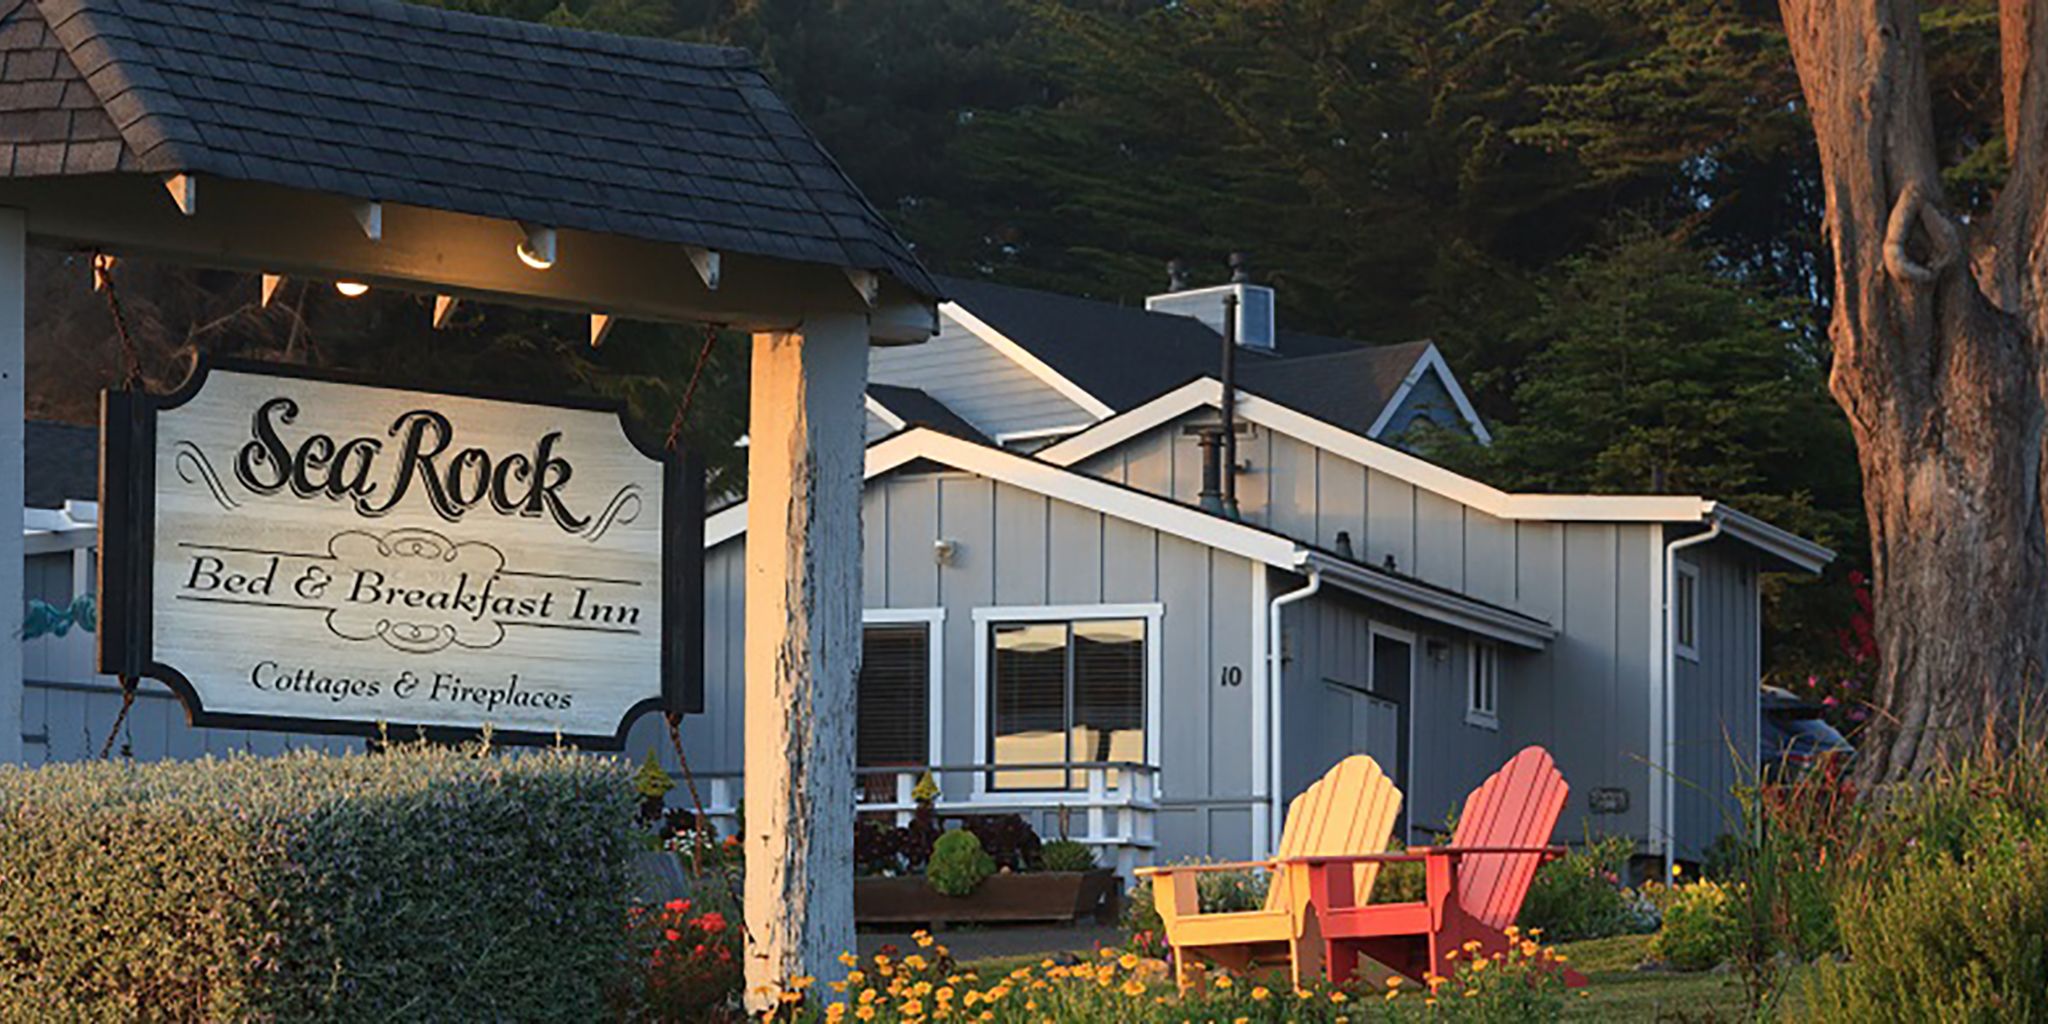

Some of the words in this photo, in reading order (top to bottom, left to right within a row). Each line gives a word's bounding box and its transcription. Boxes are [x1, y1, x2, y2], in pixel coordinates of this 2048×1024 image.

[234, 397, 382, 500] Sea
[355, 409, 591, 537] Rock
[182, 554, 280, 597] Bed
[294, 565, 332, 599] &
[346, 568, 553, 621] Breakfast
[566, 587, 640, 624] Inn
[251, 660, 380, 701] Cottages
[393, 671, 420, 696] &
[429, 673, 572, 711] Fireplaces
[1221, 666, 1242, 687] 10
